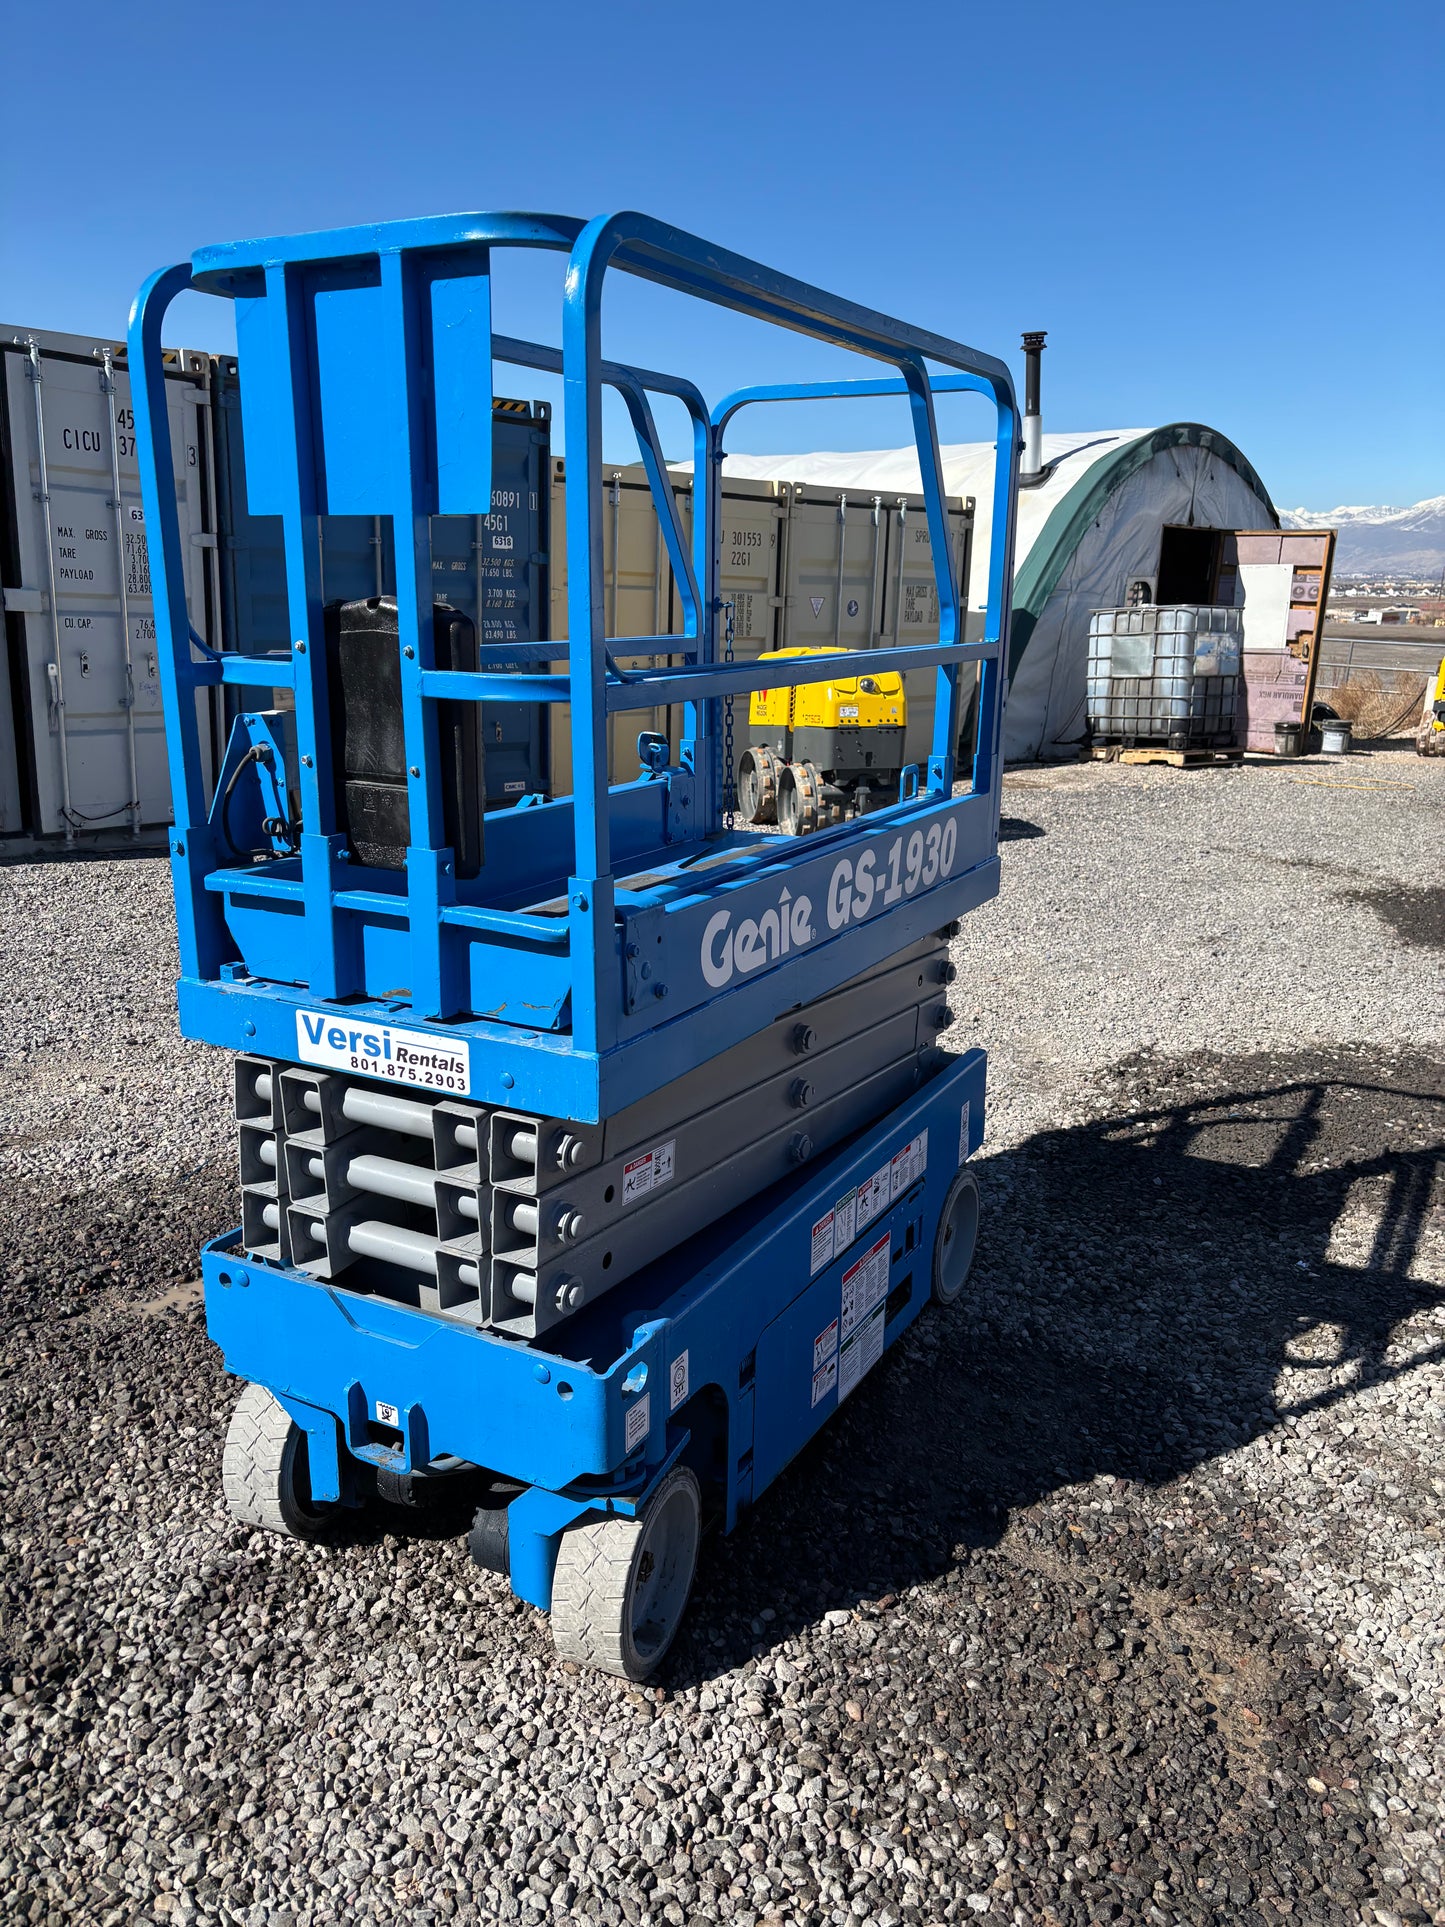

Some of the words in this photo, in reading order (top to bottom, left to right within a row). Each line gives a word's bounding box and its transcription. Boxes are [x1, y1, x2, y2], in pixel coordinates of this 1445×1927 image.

[63, 428, 101, 452] CICU
[188, 446, 197, 466] 3
[484, 514, 508, 532] 45G1
[57, 526, 76, 539] MAX.
[85, 528, 108, 541] GROSS
[125, 533, 147, 545] 32.50
[494, 537, 512, 547] 6318
[732, 531, 762, 547] 301553
[770, 534, 776, 547] 9
[59, 547, 77, 559] TARE
[126, 543, 149, 555] 71.65
[451, 562, 467, 571] GROSS
[731, 551, 751, 567] 22G1
[60, 568, 94, 581] PAYLOAD
[77, 618, 94, 630] CAP.
[701, 886, 812, 988] Genie
[826, 817, 958, 930] GS-1930
[302, 1014, 392, 1060] Versi
[396, 1047, 465, 1074] Rentals
[350, 1056, 467, 1091] 801.875.2903
